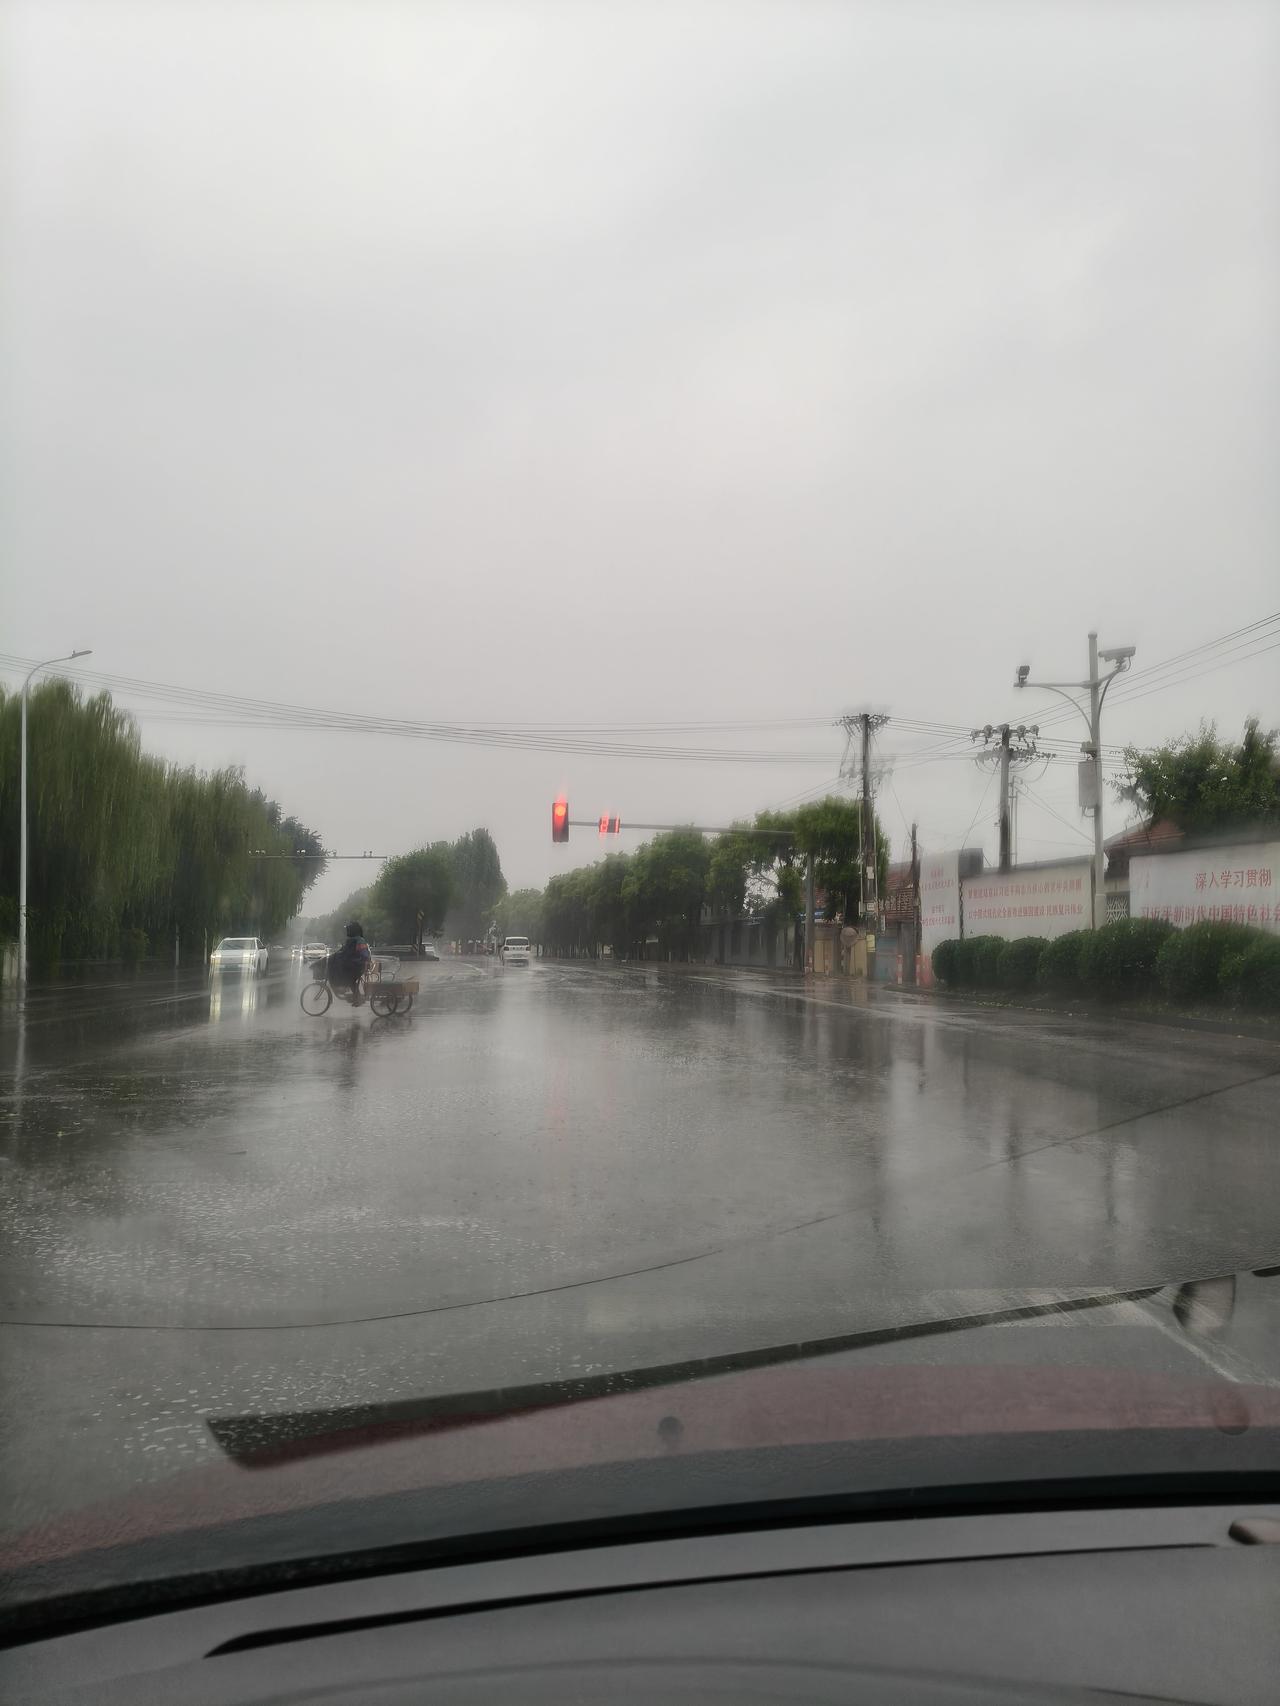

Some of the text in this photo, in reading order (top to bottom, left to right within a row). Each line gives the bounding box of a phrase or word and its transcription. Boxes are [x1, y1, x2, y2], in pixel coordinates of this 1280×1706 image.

[1195, 867, 1272, 889] 深入学习贯彻
